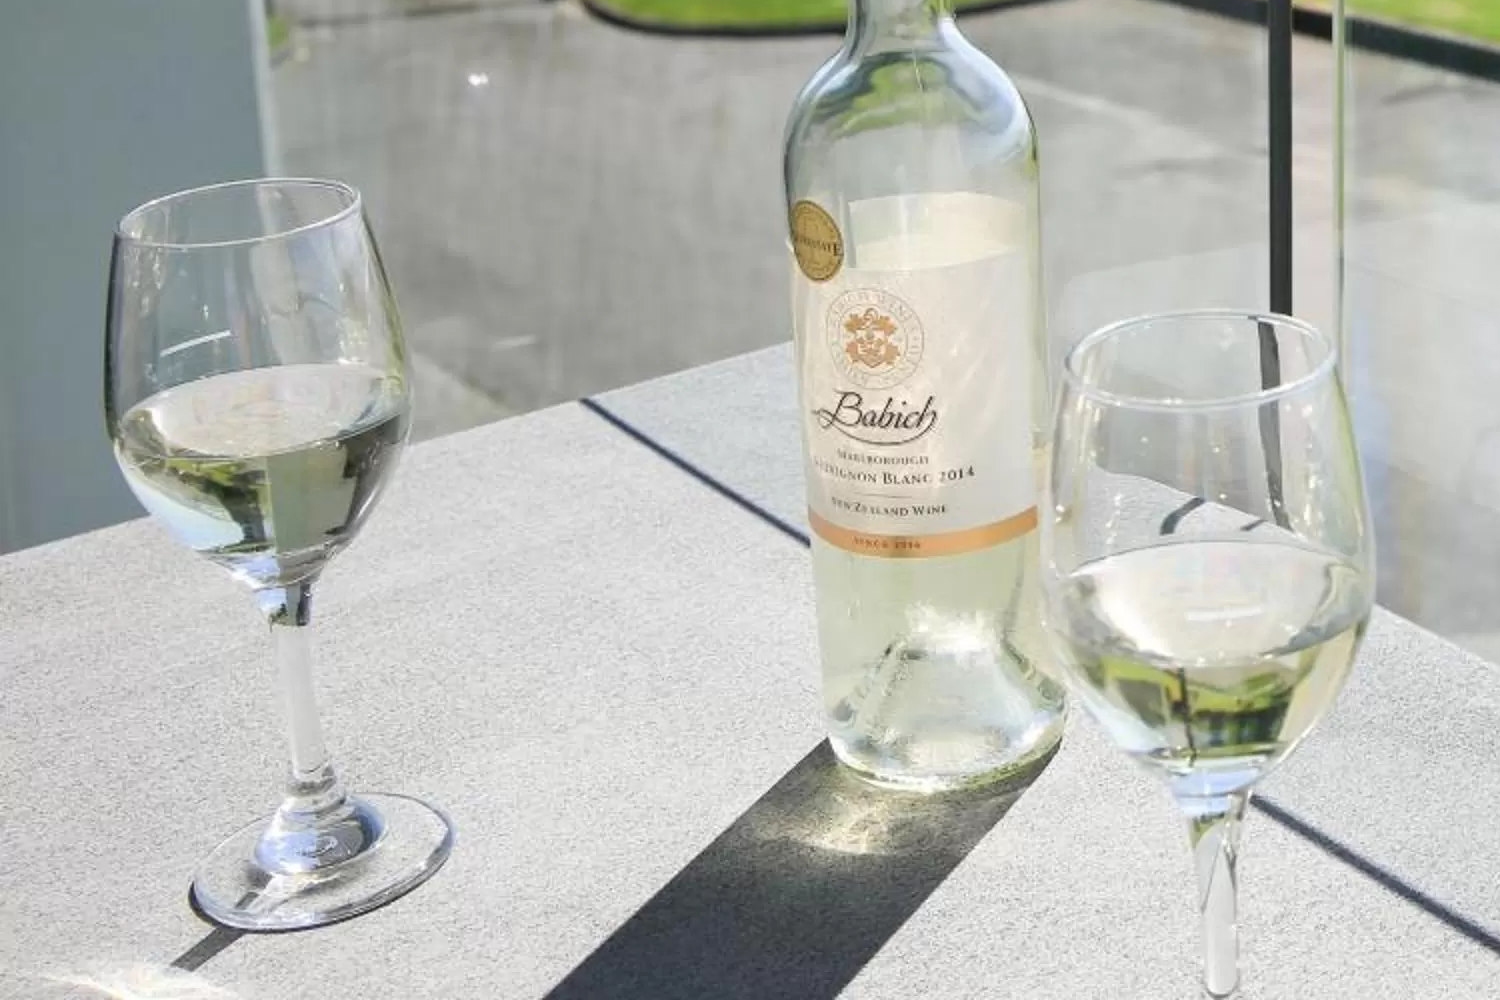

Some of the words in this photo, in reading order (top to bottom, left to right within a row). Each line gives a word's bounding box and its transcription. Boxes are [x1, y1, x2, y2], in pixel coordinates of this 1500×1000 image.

[811, 389, 937, 446] Babich
[882, 471, 932, 485] BLANC
[939, 464, 975, 481] 2014
[911, 504, 947, 516] WINE
